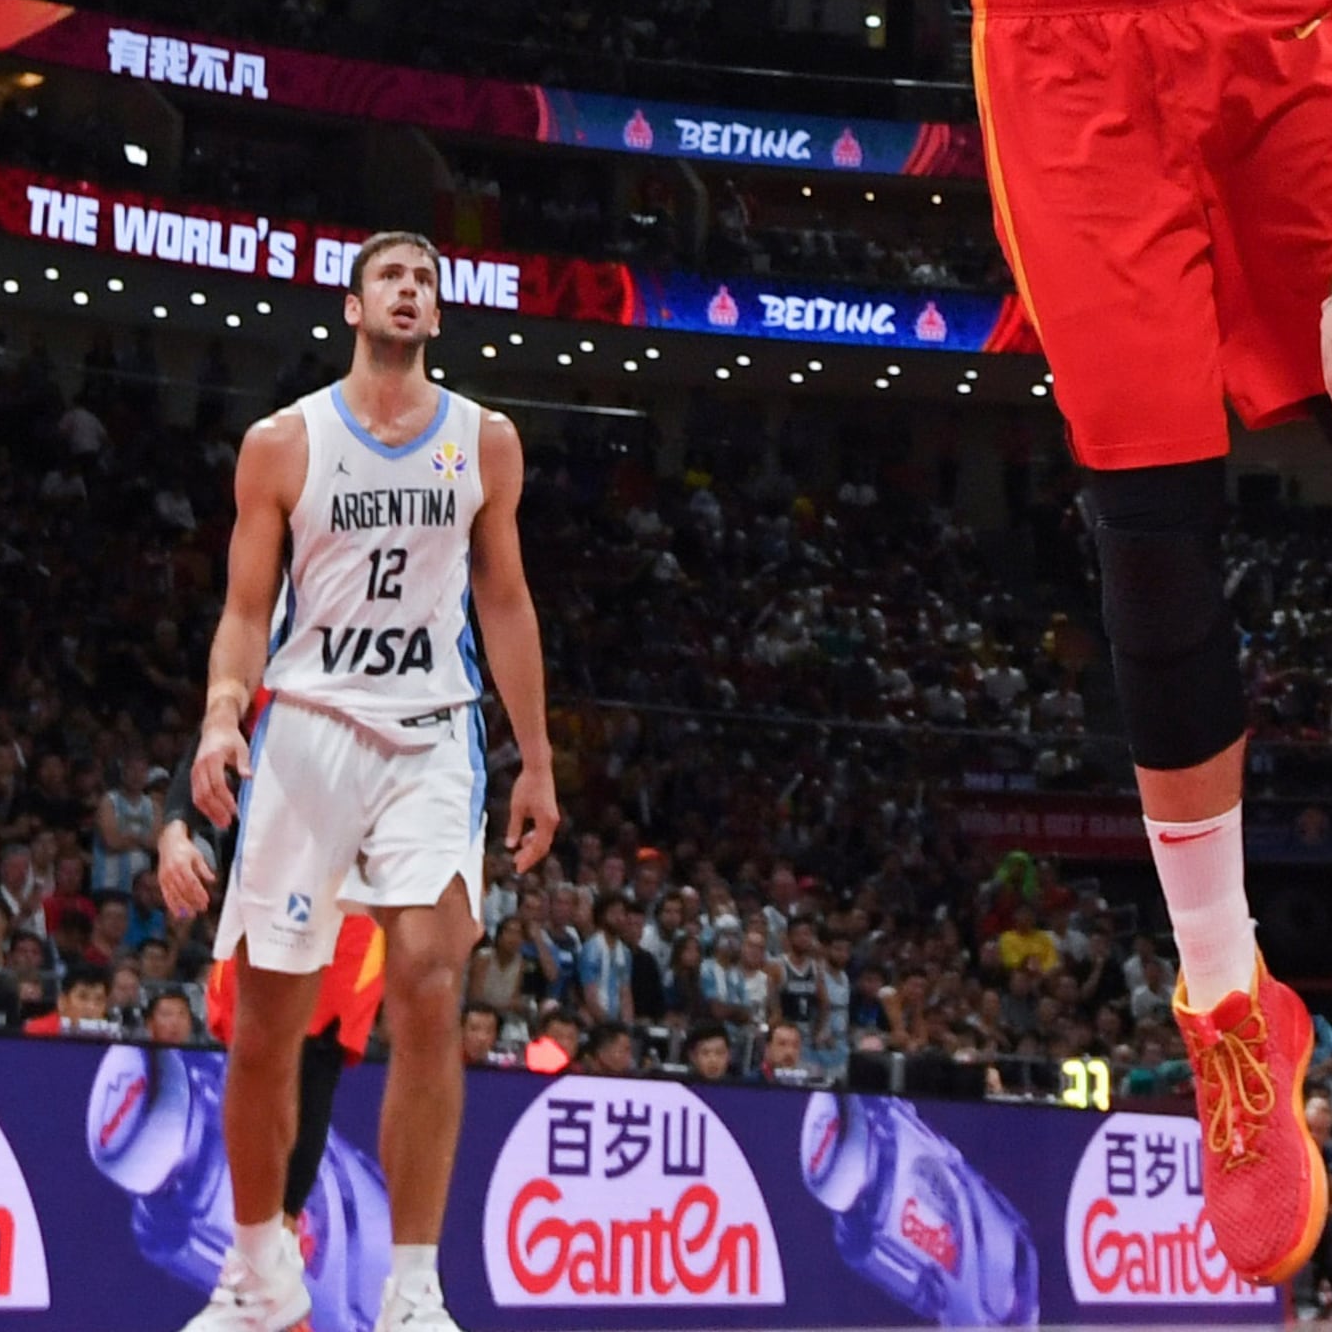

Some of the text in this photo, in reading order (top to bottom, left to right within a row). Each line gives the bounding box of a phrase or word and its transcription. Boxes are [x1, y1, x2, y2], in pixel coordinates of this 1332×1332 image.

[107, 27, 269, 100] 有我不凡
[674, 118, 811, 161] BEIJING
[26, 185, 100, 246] THE
[113, 203, 297, 279] WORLD'S
[758, 293, 896, 336] BEIJING
[331, 488, 456, 533] ARGENTINA
[366, 548, 408, 602] 12
[314, 626, 434, 676] VISA
[547, 1099, 707, 1179] 百岁山
[506, 1177, 760, 1297] Ganten
